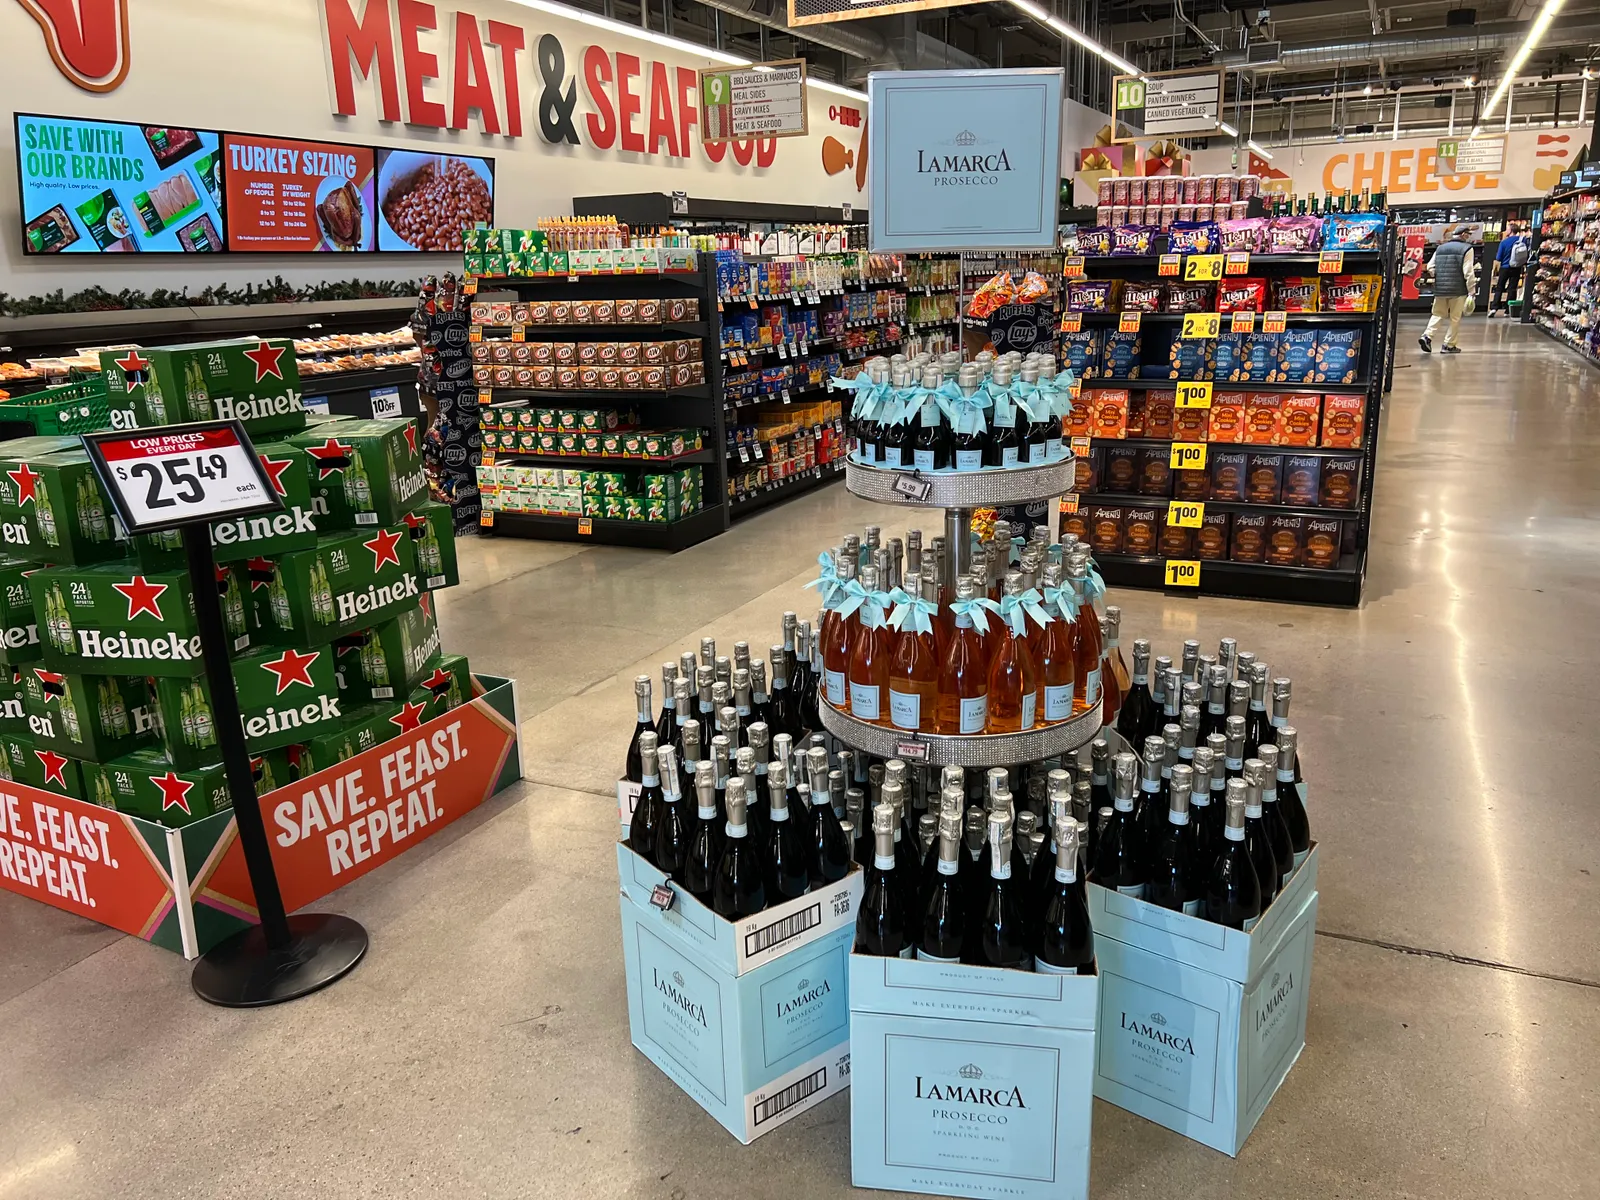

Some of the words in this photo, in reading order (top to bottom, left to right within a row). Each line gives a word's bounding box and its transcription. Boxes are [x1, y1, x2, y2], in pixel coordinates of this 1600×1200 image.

[323, 0, 525, 137] MEAT
[533, 33, 580, 146] &
[733, 77, 743, 85] BBQ
[744, 75, 762, 84] SAUCES
[769, 71, 798, 82] MARINADES
[711, 79, 723, 102] 9
[1148, 83, 1164, 91] SOUP
[734, 91, 748, 100] MEAL
[750, 90, 766, 98] SIDES
[1119, 84, 1143, 107] 10
[1148, 96, 1169, 105] PANTRY
[1171, 93, 1196, 102] DINNERS
[734, 107, 752, 115] GRAVY
[753, 105, 769, 113] MIXES
[1147, 109, 1170, 118] CANNED
[1171, 106, 1206, 116] VEGETABLES
[735, 122, 749, 130] MEAT
[757, 119, 782, 129] SEAFOOD
[25, 124, 73, 151] SAVE
[77, 127, 124, 154] WITH
[1440, 144, 1455, 156] 11
[27, 152, 67, 178] OUR
[71, 154, 144, 182] BRANDS
[229, 144, 299, 174] TURKEY
[303, 151, 356, 178] SIZING
[45, 182, 67, 190] quality.
[81, 183, 100, 191] prices.
[250, 182, 274, 190] NUMBER
[934, 176, 998, 186] PROSECCO
[1065, 267, 1082, 276] SALE
[1187, 262, 1197, 278] 2
[1319, 262, 1341, 273] SALE
[1062, 322, 1080, 332] SALE
[1184, 320, 1194, 335] 2
[1264, 322, 1284, 332] SALE
[208, 353, 222, 365] 24
[214, 389, 304, 421] Heinek
[385, 402, 395, 411] OFF
[130, 437, 161, 450] LOW
[163, 432, 205, 446] PRICES
[146, 444, 176, 455] EVERY
[178, 442, 196, 452] DAY
[236, 483, 256, 493] each
[209, 506, 316, 546] einek
[330, 549, 343, 563] 24
[6, 585, 23, 597] 24
[70, 582, 86, 594] 24
[336, 572, 418, 622] Heinek
[26, 677, 35, 688] 24
[240, 694, 341, 741] einek
[115, 771, 128, 783] 24
[273, 768, 377, 848] SAVE.
[380, 720, 469, 791] FEAST.
[325, 778, 445, 877] REPEAT.
[33, 802, 119, 869] FEAST.
[0, 837, 96, 908] REPEAT.
[786, 1001, 823, 1026] PROSECCO
[912, 1000, 935, 1008] MAKE
[940, 1002, 988, 1012] EVERYDAY
[991, 1007, 1031, 1016] SPARKLE
[662, 1002, 700, 1037] PROSECCO
[1132, 1039, 1183, 1064] PROSECCO
[932, 1109, 1008, 1125] PROSECCO
[933, 1130, 980, 1140] SPARKLING
[939, 1181, 984, 1191] EVERYDAY
[987, 1187, 1025, 1195] SPARKLE
